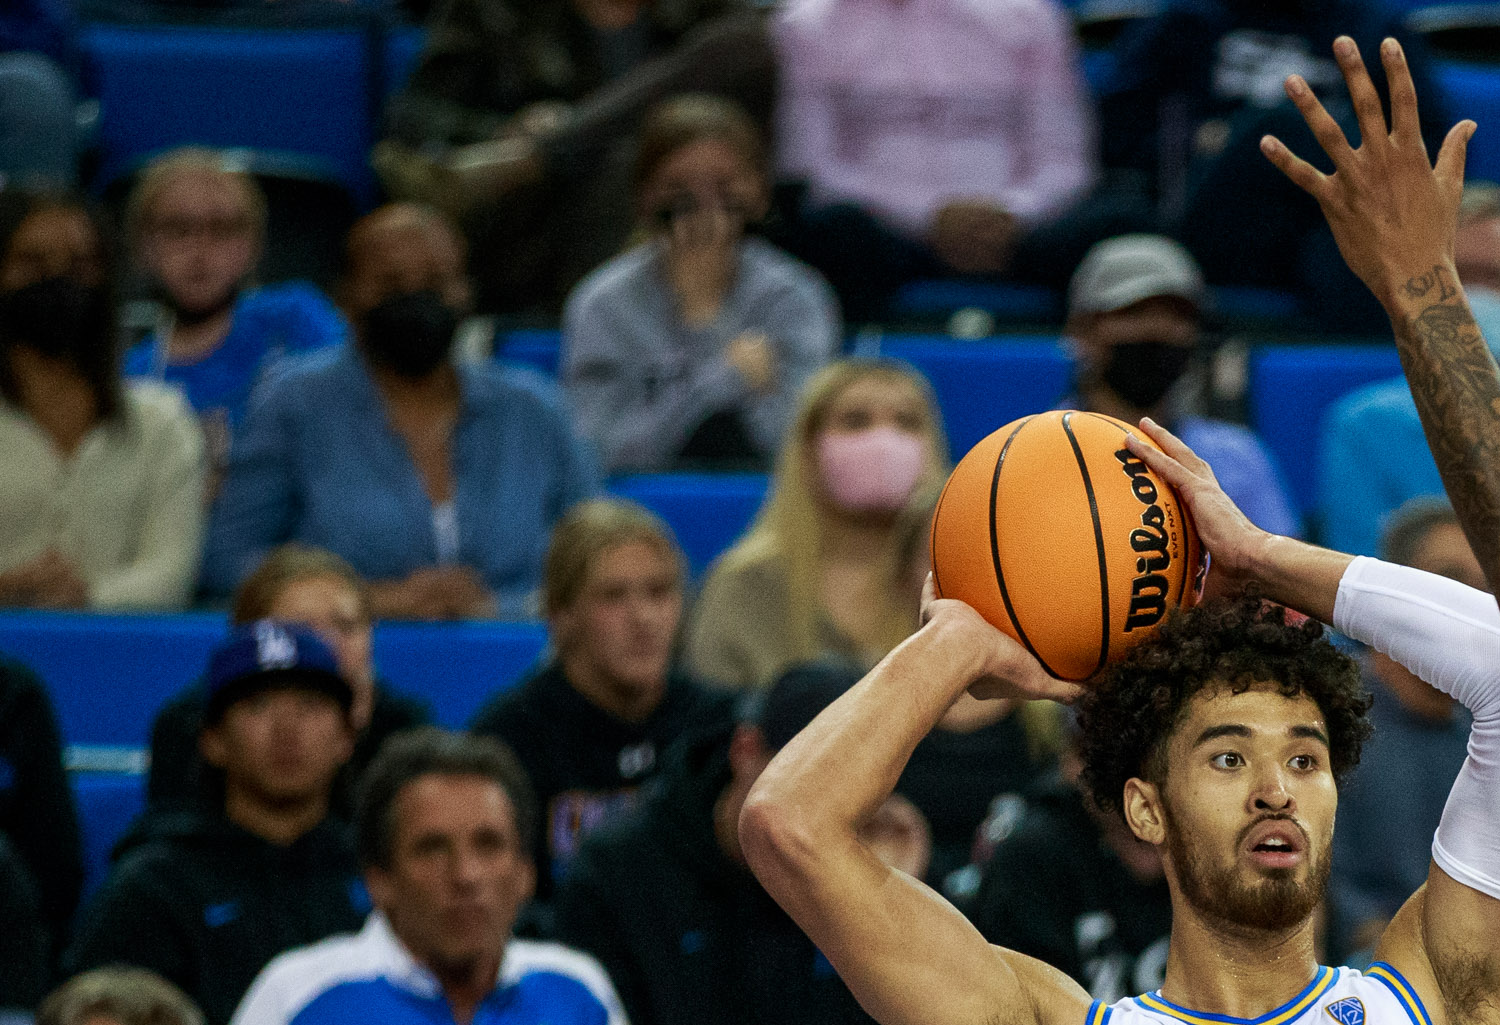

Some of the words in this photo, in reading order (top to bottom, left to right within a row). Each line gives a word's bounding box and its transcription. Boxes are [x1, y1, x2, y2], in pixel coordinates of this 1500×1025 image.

[1164, 501, 1175, 527] NXT
[1114, 448, 1170, 632] Wilson
[1171, 531, 1179, 559] EVO
